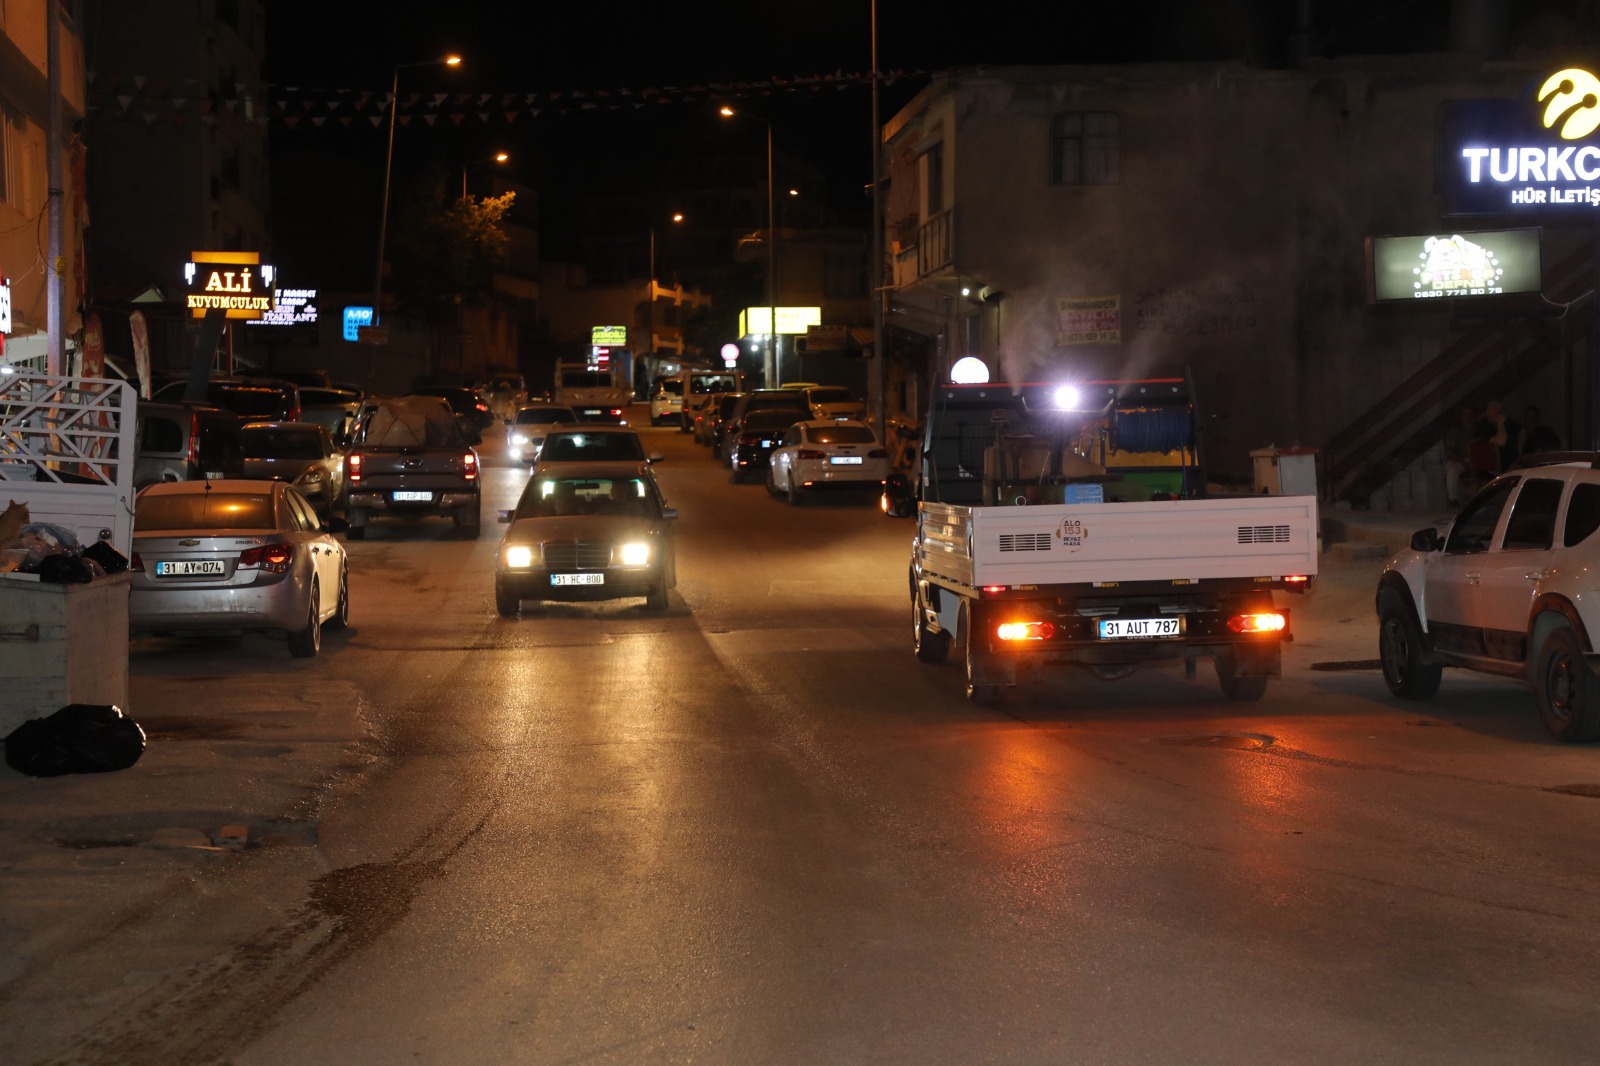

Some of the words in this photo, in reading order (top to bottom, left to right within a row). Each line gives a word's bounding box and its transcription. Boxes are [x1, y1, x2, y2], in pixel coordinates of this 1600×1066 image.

[1512, 187, 1546, 203] HÜR
[206, 268, 251, 292] ALİ
[1433, 279, 1485, 289] DEFNE
[283, 289, 316, 298] MARKET
[1414, 290, 1443, 298] 0530
[188, 295, 269, 309] KUYUMCULUK
[1063, 526, 1081, 535] 153
[164, 563, 176, 573] 31
[184, 562, 196, 573] AY
[202, 561, 221, 573] 074
[556, 575, 566, 584] 31
[570, 575, 581, 584] HC
[1106, 622, 1119, 635] 31
[1126, 621, 1149, 635] AUT
[1155, 620, 1178, 633] 787
